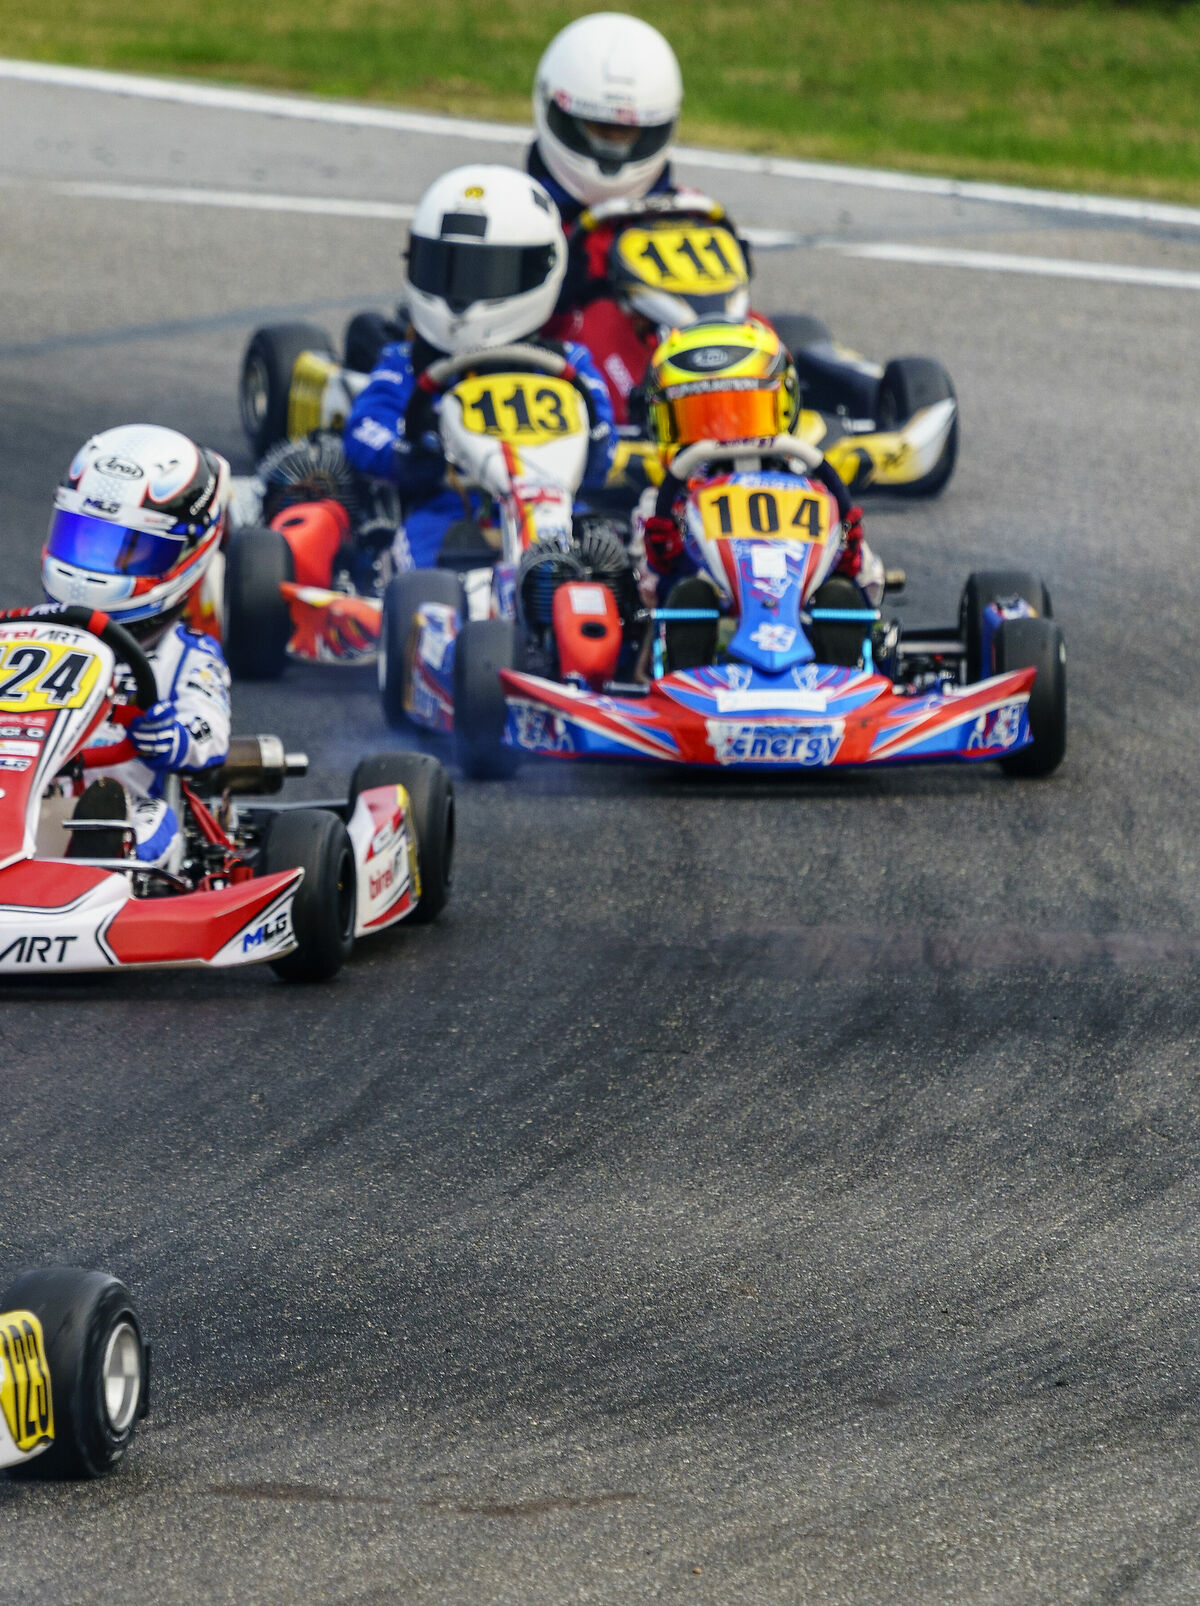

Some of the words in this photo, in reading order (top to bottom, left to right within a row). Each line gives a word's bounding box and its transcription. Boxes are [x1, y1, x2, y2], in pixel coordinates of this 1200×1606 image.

[641, 236, 732, 278] 111
[471, 387, 568, 434] 113
[711, 492, 823, 537] 104
[242, 911, 287, 953] MLG
[0, 1319, 49, 1443] 123
